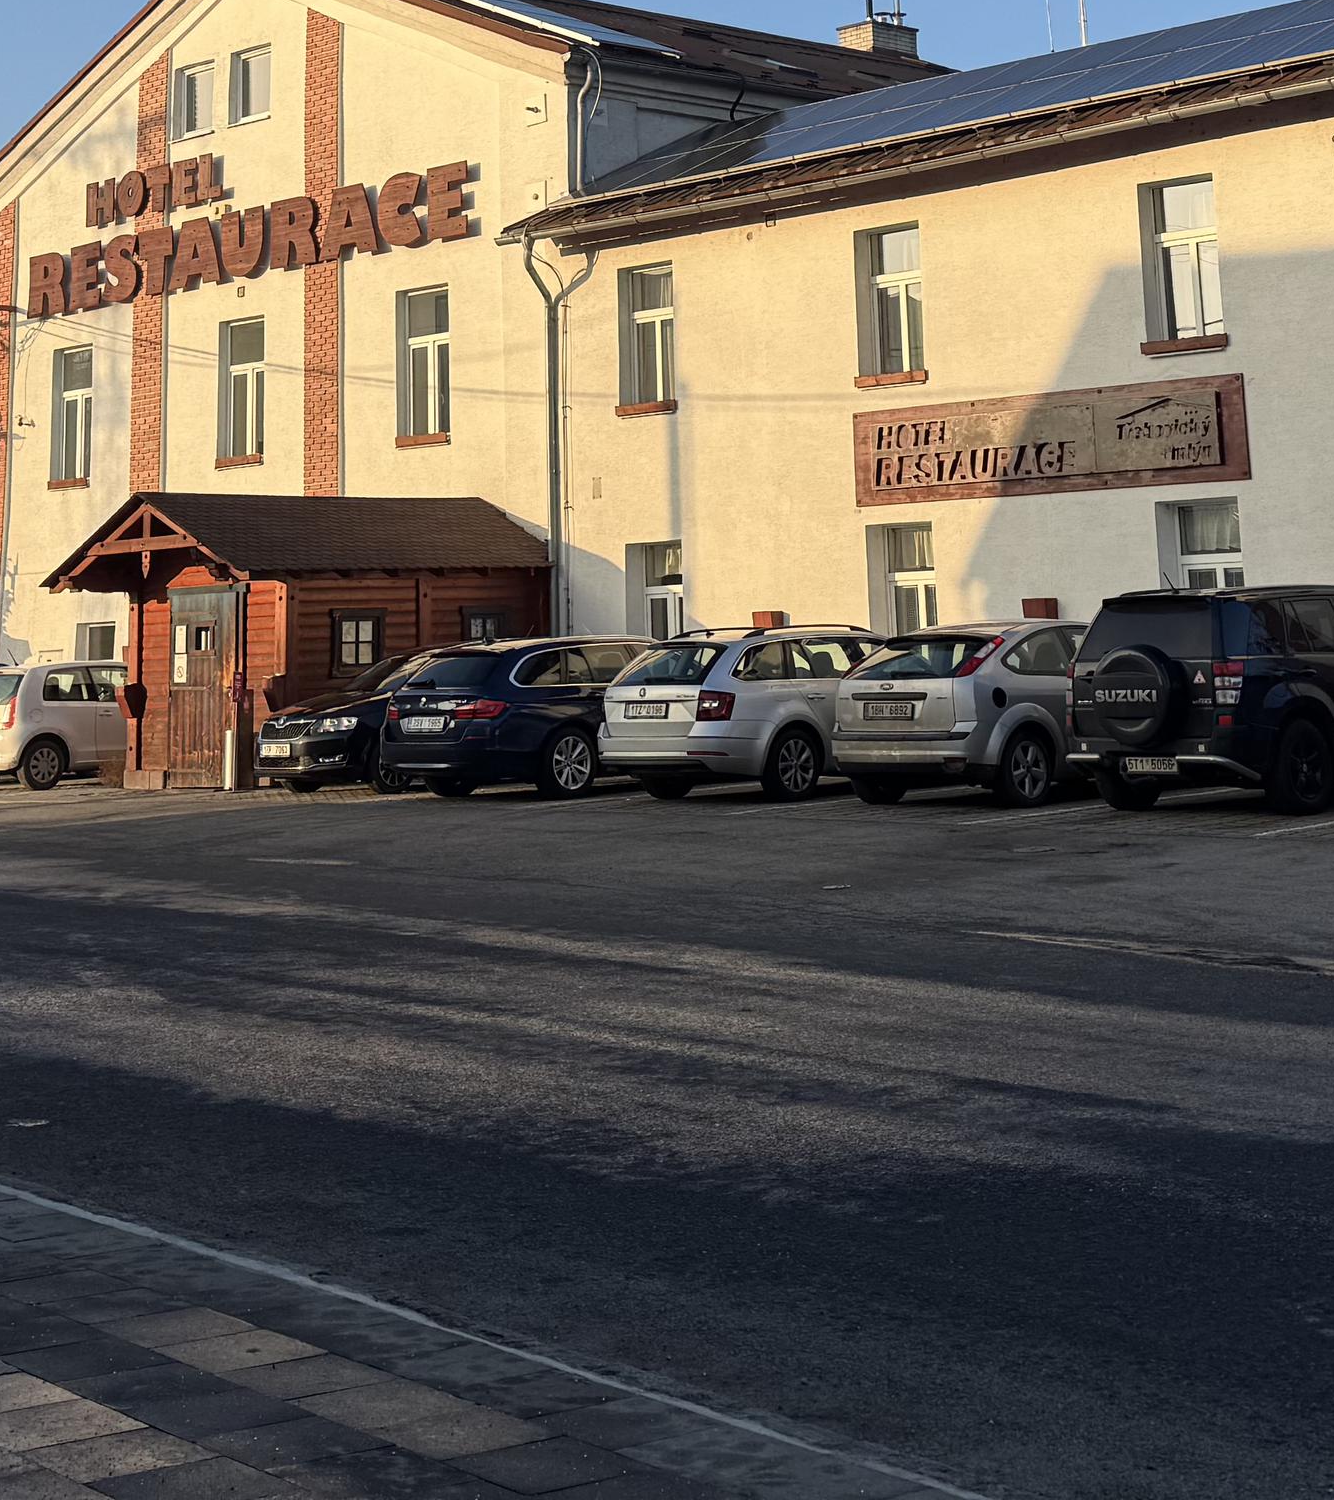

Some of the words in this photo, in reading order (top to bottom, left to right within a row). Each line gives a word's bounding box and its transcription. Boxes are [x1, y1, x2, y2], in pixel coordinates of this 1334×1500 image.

[85, 152, 224, 228] HOTEL
[26, 159, 470, 320] RESTAURACE
[876, 420, 952, 451] HOTEL
[874, 440, 1077, 488] RESTAURACE
[1094, 688, 1158, 703] SUZUKI
